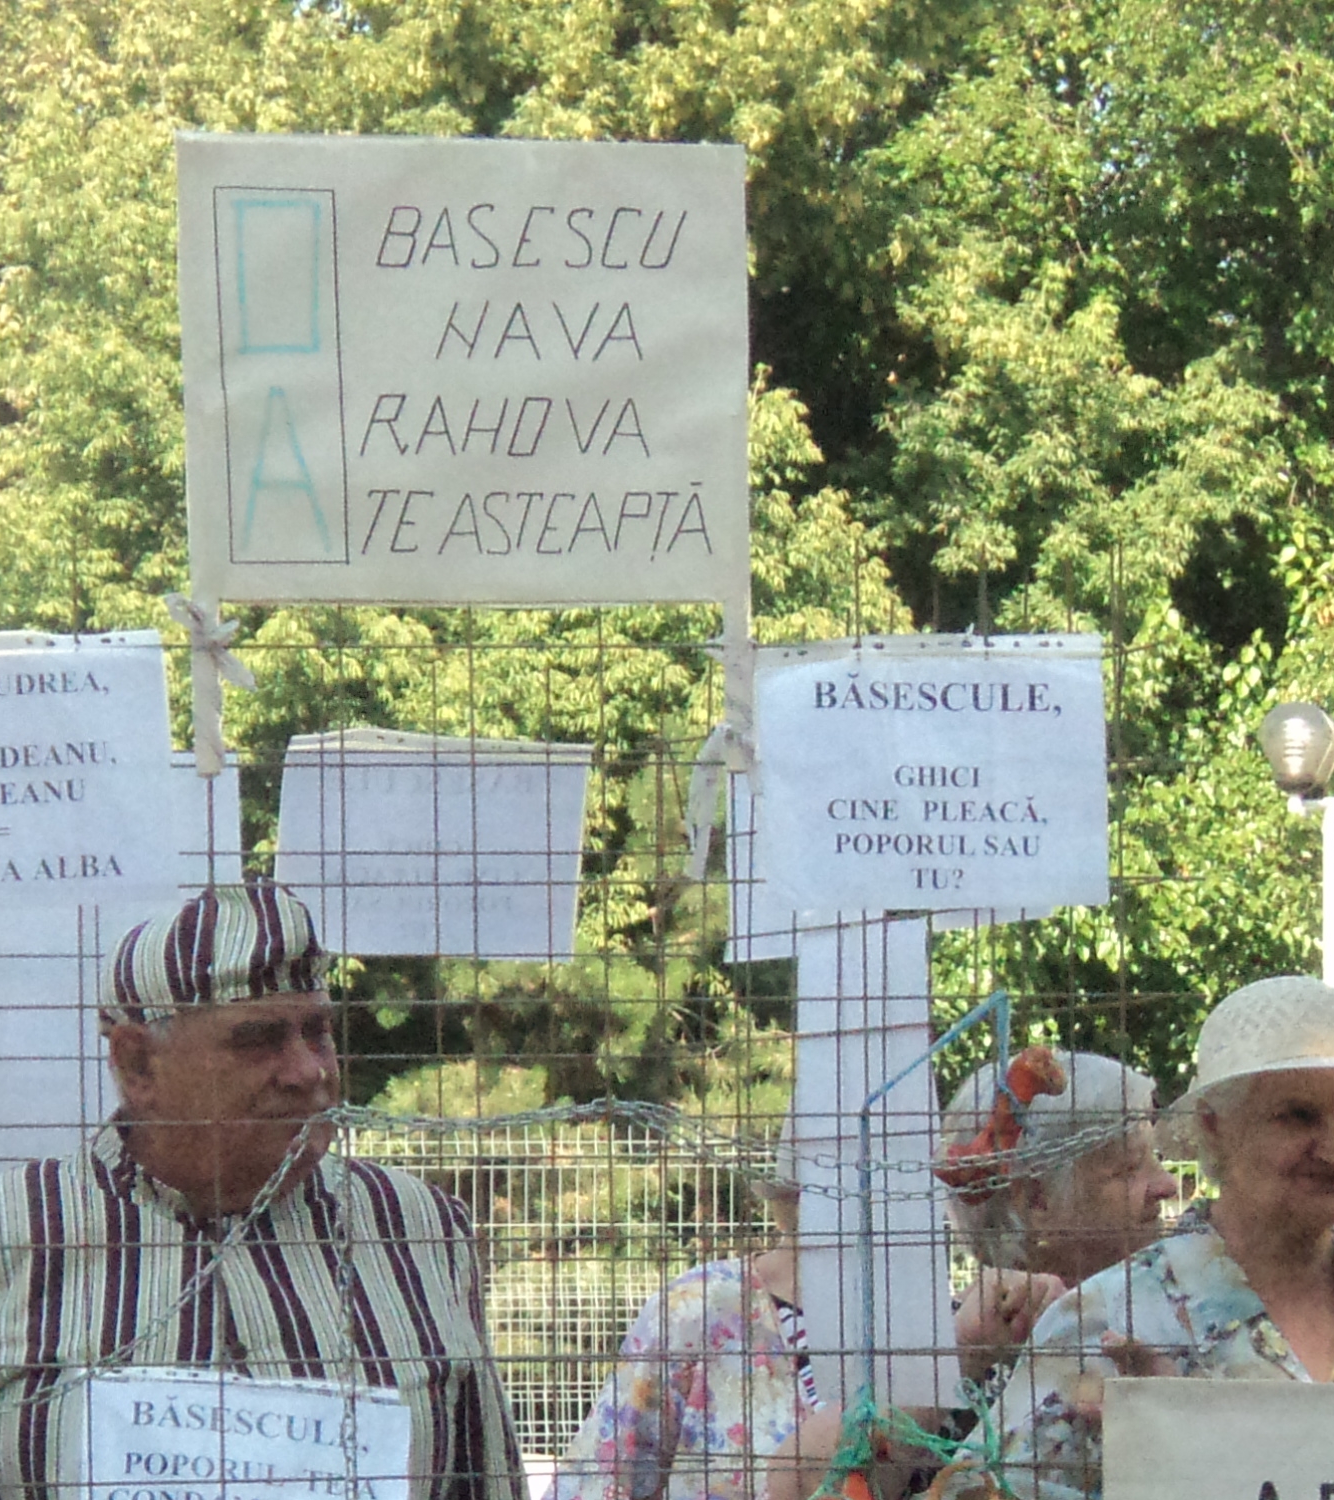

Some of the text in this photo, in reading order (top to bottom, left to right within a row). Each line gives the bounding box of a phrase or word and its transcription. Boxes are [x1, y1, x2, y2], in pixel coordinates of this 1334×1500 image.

[375, 203, 687, 269] BASESCU
[436, 301, 644, 361] NAVA
[360, 394, 651, 457] RAHOVA
[361, 489, 434, 556] TE
[814, 673, 1062, 717] BĂSESCULE,
[893, 764, 981, 788] GHICI
[827, 796, 1048, 825] CINE PLEACĂ,
[834, 833, 1040, 857] POPORUL SAU
[33, 854, 123, 881] ALBA
[911, 868, 963, 890] TU?
[131, 1395, 368, 1454] BĂSESCUL,
[124, 1452, 285, 1488] POPORUL
